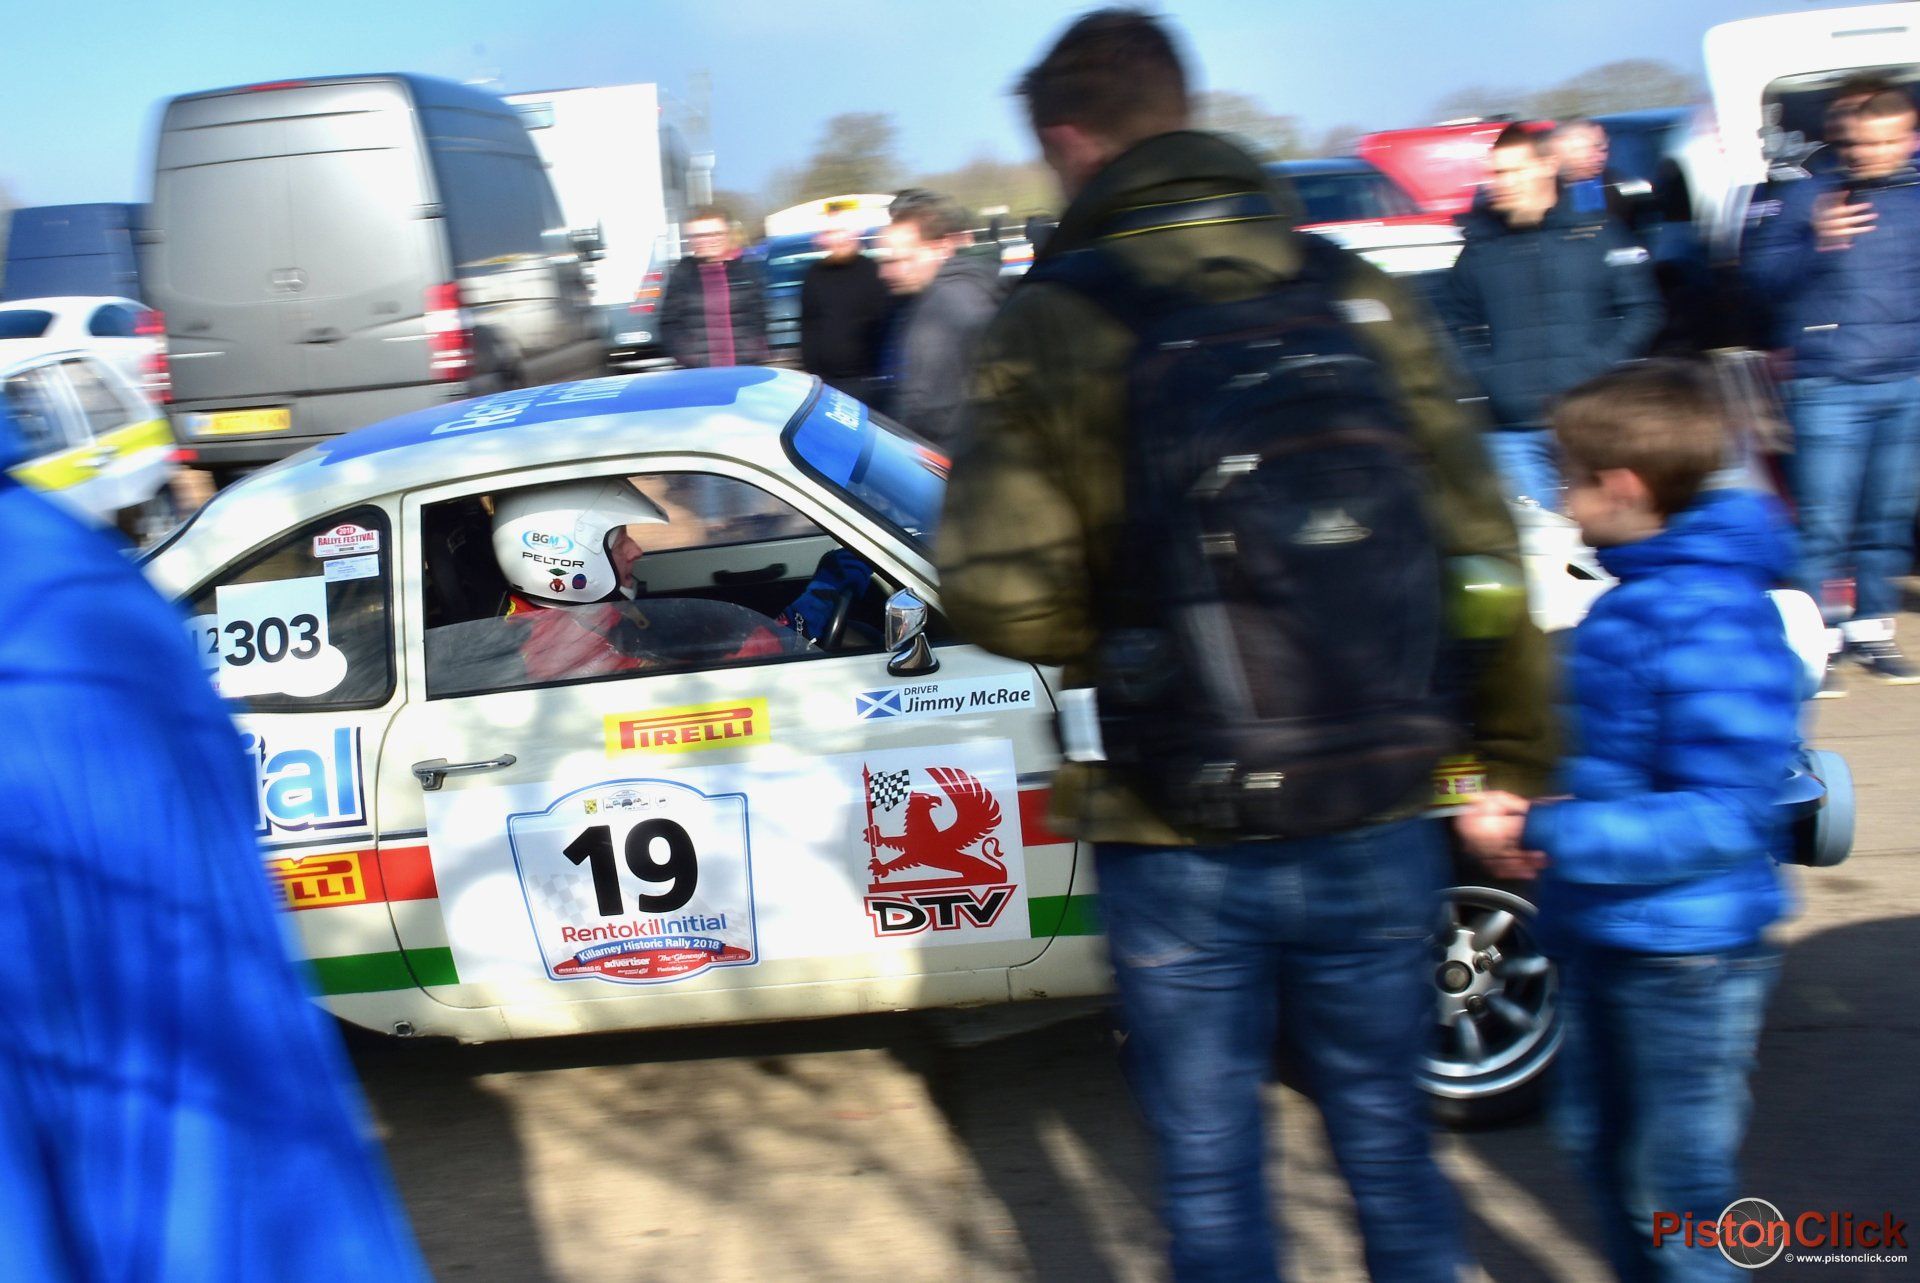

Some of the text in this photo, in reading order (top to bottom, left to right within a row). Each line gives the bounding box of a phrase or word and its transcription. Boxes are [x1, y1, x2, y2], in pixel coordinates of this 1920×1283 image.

[318, 532, 375, 546] RALLYE FESTIVAL
[532, 532, 559, 546] BGM
[522, 551, 585, 568] PELTOR
[224, 613, 321, 667] 303
[903, 684, 939, 696] DRIVER
[905, 688, 1031, 713] Jimmy McRae
[619, 707, 754, 750] PIRELLI
[562, 817, 699, 917] 19
[863, 884, 1018, 938] DTV
[578, 938, 720, 962] Killarney Historic Rally 2018
[603, 956, 650, 968] advertiser
